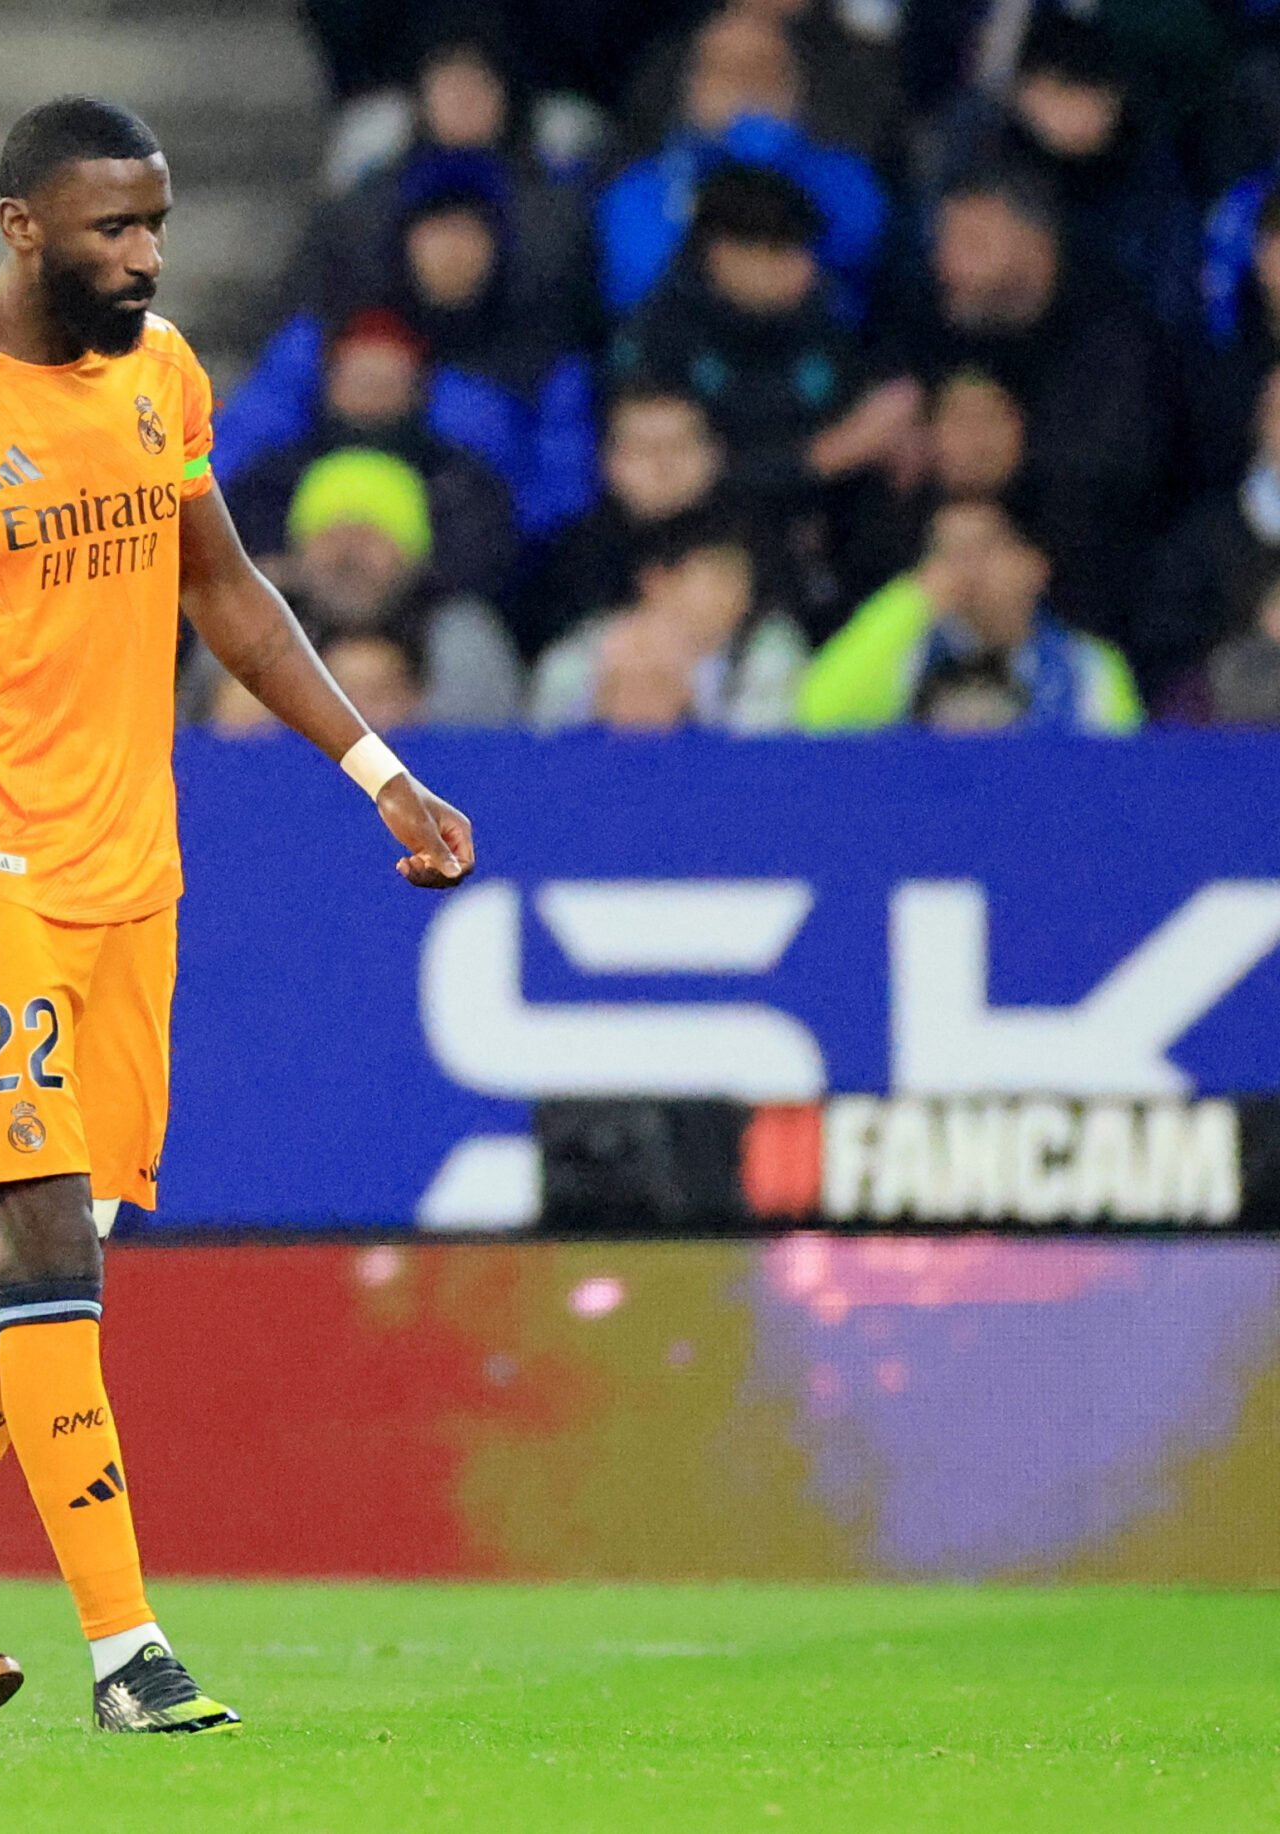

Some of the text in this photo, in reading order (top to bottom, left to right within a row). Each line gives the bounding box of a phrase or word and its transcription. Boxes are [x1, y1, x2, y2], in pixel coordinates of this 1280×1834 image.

[0, 482, 178, 551] Emirates
[41, 532, 158, 590] FLY BETTER
[820, 1095, 1241, 1222] FANCAM
[52, 1407, 104, 1438] RMC
